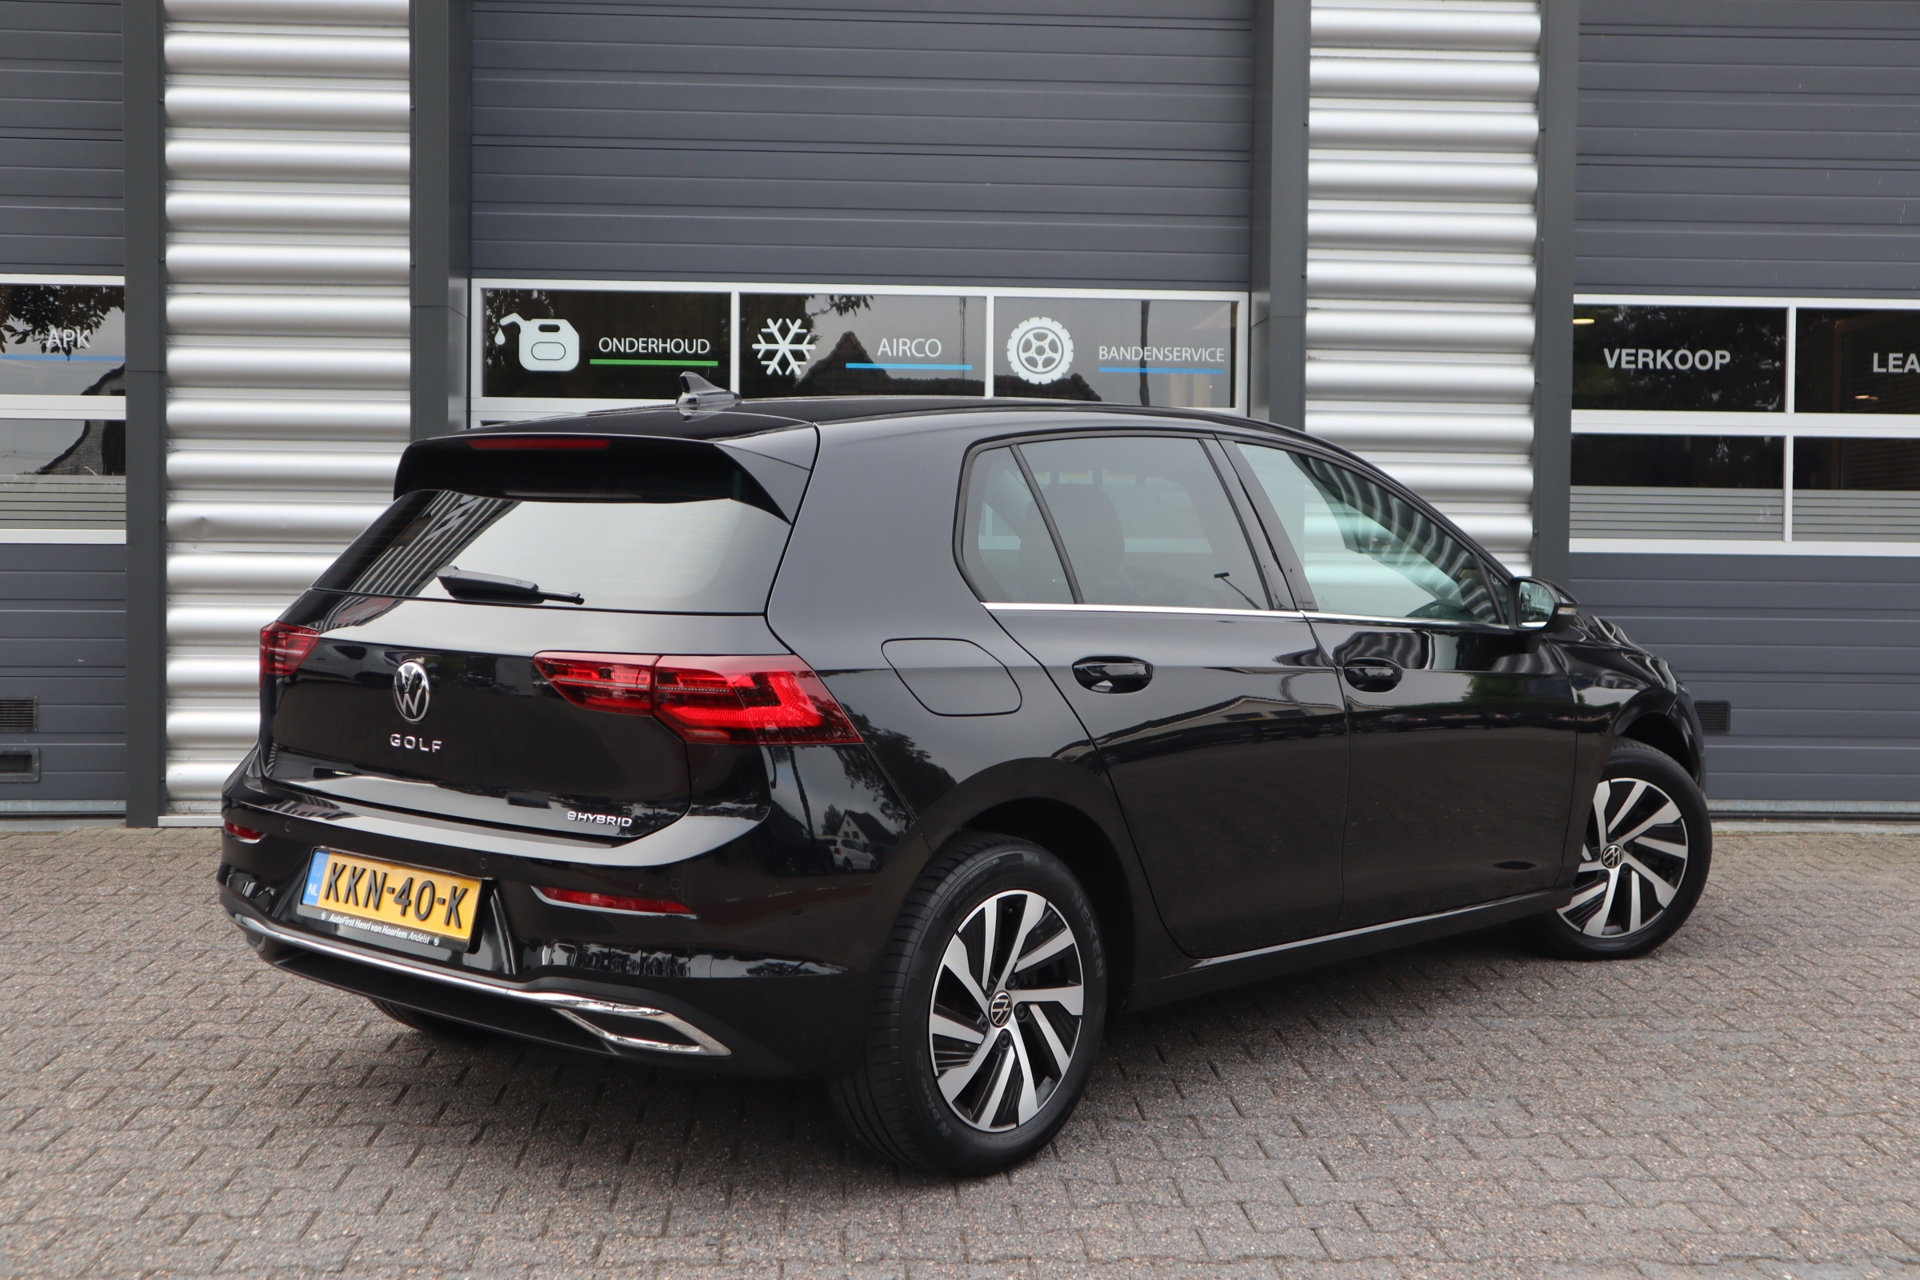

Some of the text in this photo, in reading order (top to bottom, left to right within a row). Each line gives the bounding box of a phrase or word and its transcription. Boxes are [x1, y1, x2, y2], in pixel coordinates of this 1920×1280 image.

[46, 328, 91, 350] APK
[598, 336, 710, 355] ONDERHOUD
[876, 337, 942, 358] AIRCO
[1098, 344, 1225, 363] BANDENSERVICE
[1603, 347, 1731, 372] VERKOOP
[1873, 352, 1920, 373] LEA
[389, 733, 443, 754] GOLF
[566, 809, 634, 829] eHYBRID
[307, 882, 319, 897] NL
[324, 862, 468, 929] KKN-40-K
[328, 913, 355, 927] AutoFirst
[354, 919, 371, 931] Henri
[370, 924, 382, 933] van
[382, 925, 408, 939] Haarlem
[1070, 889, 1104, 978] NEXEN
